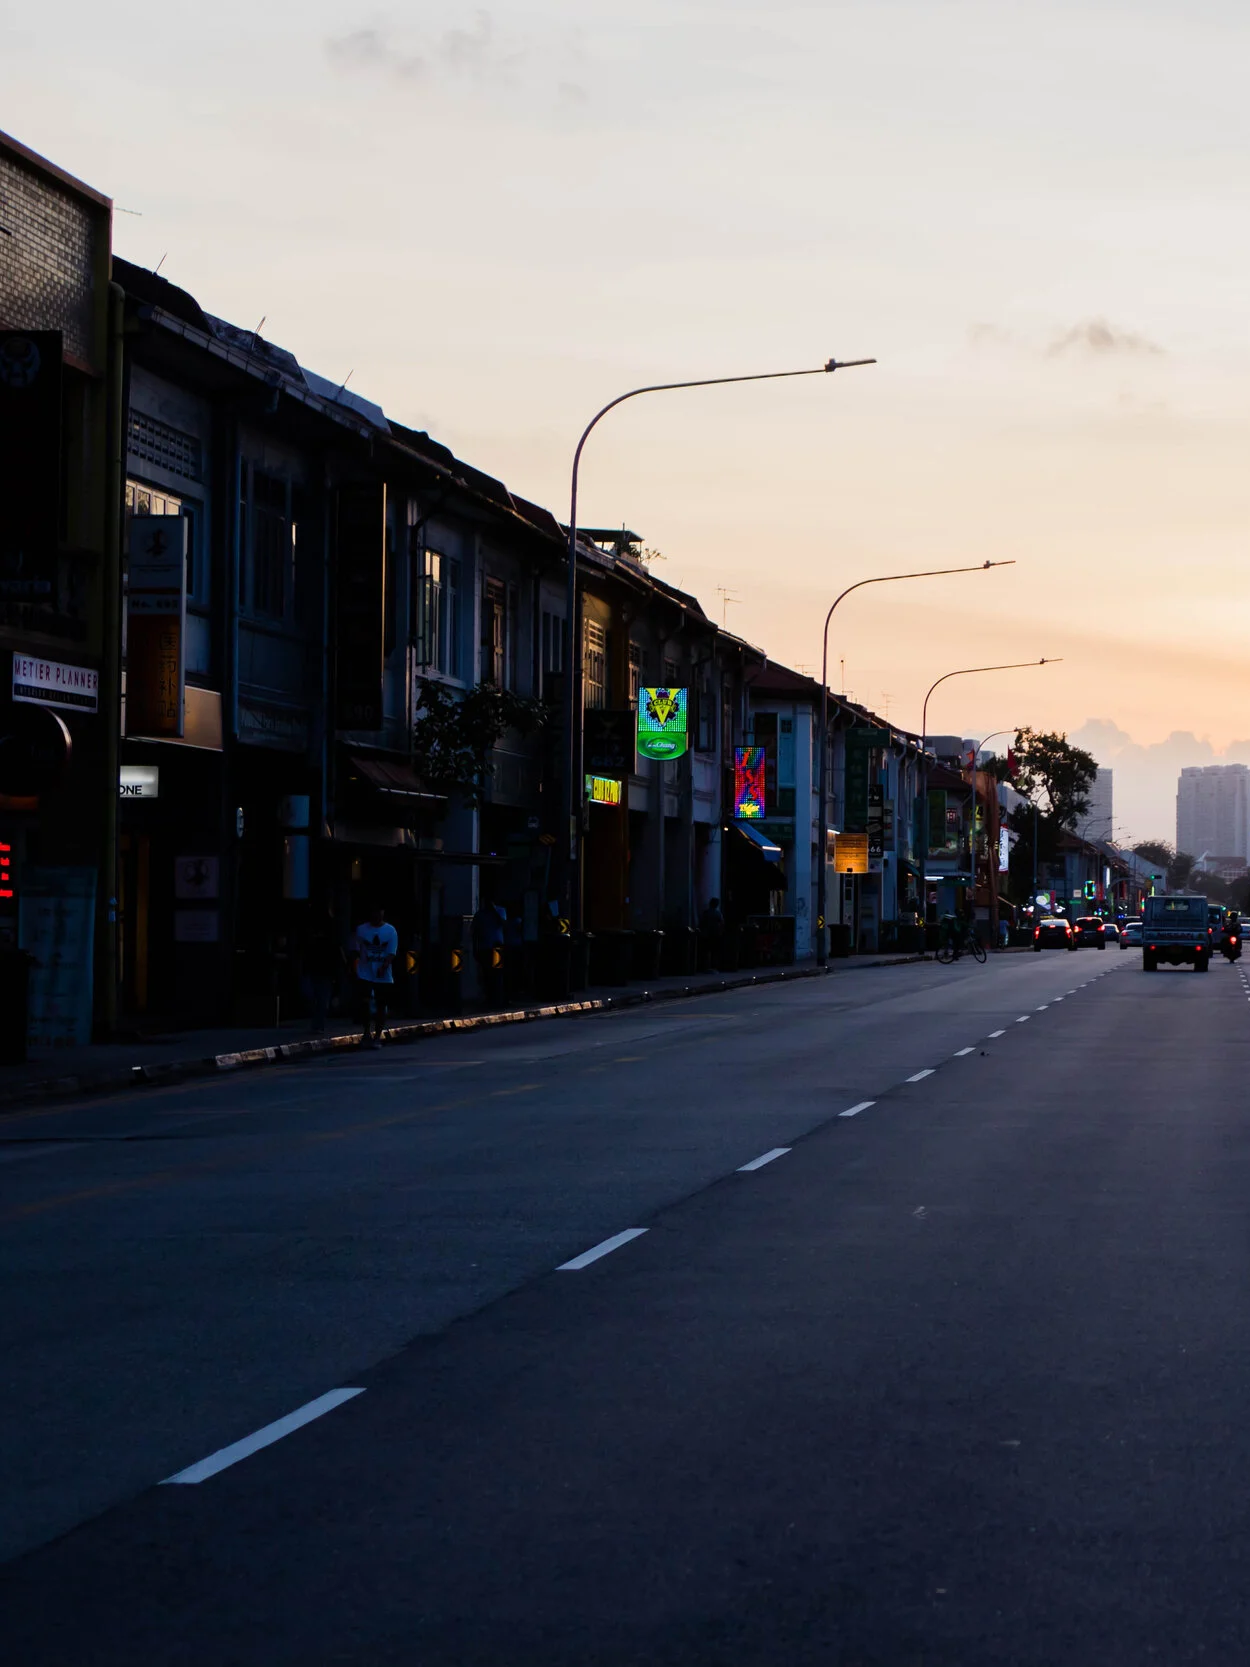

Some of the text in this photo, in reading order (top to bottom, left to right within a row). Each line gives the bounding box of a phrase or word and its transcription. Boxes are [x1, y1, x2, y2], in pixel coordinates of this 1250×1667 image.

[14, 659, 98, 690] METIER PLANNER
[653, 698, 674, 706] CLUB
